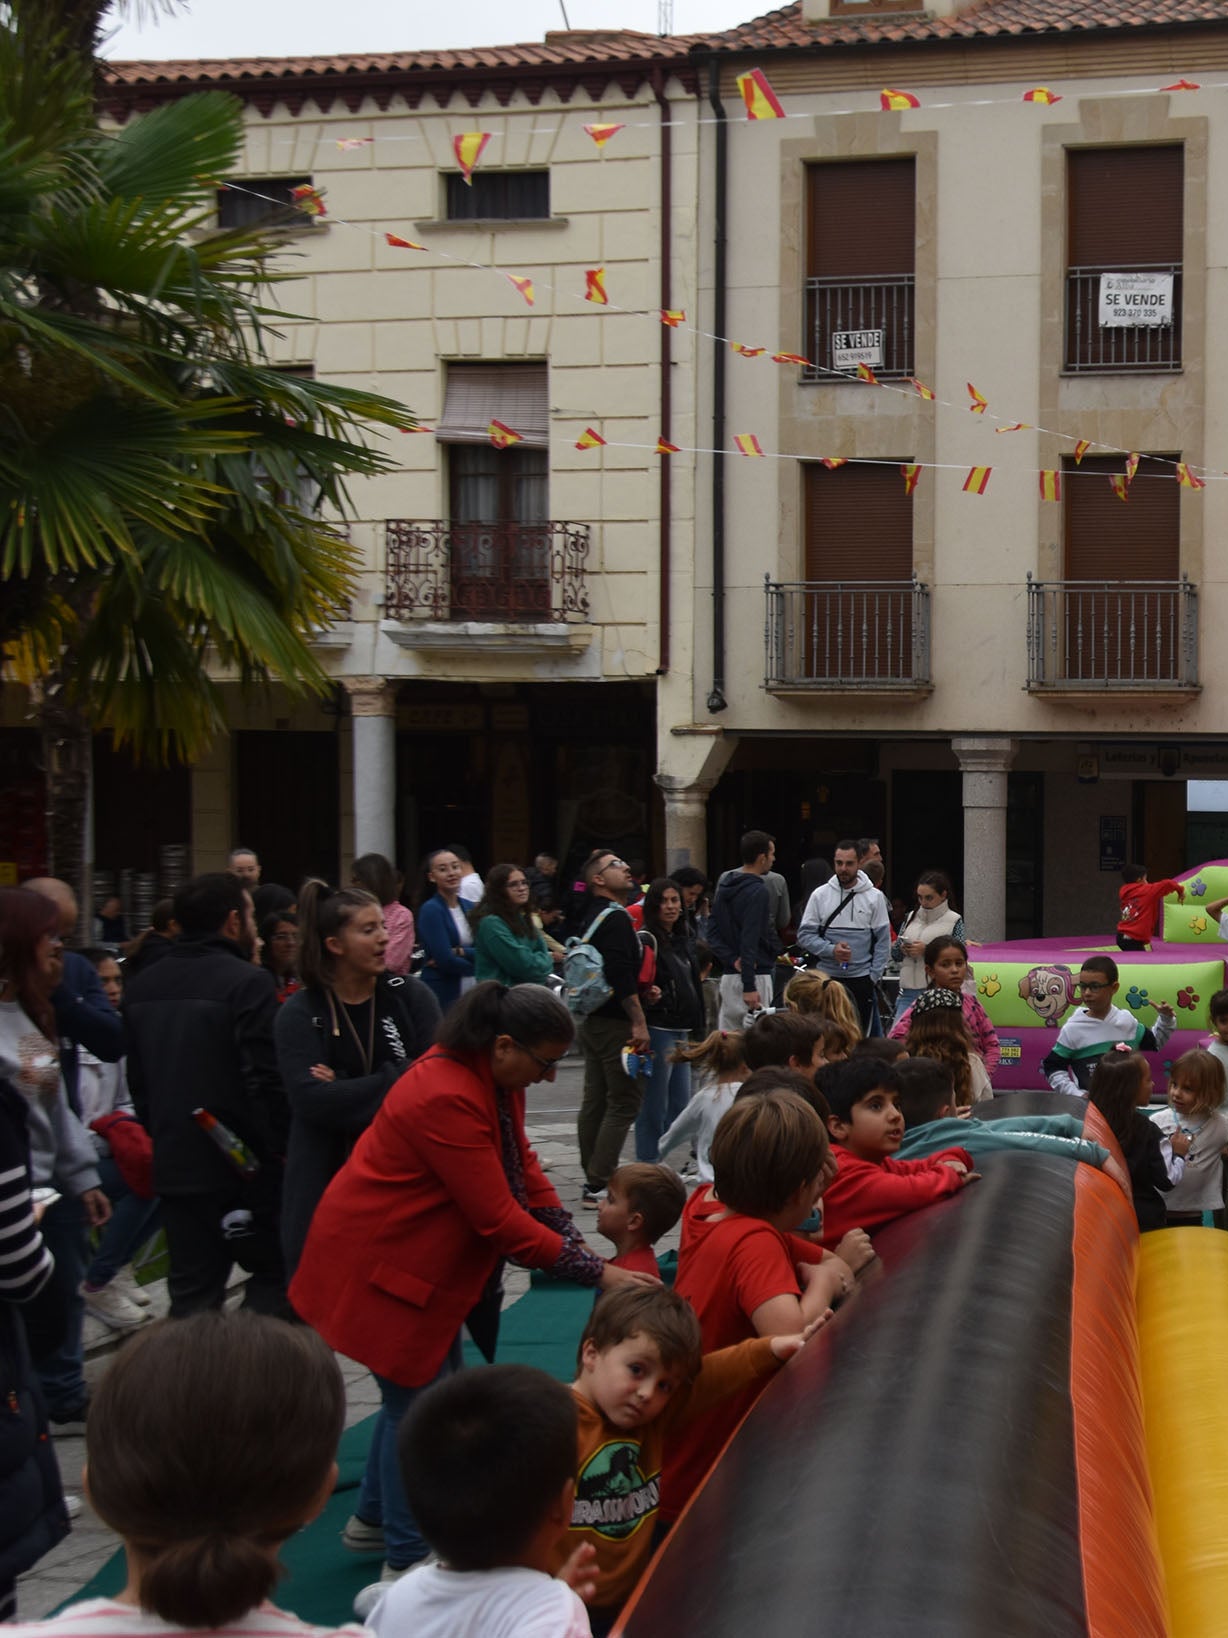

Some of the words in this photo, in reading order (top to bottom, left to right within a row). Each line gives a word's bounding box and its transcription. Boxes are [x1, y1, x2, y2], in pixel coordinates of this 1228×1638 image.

[1105, 293, 1121, 305] SE
[1124, 294, 1166, 306] VENDE
[1113, 308, 1127, 317] 923
[1143, 308, 1157, 318] 335
[835, 334, 847, 349] SE
[849, 332, 880, 348] VENDE
